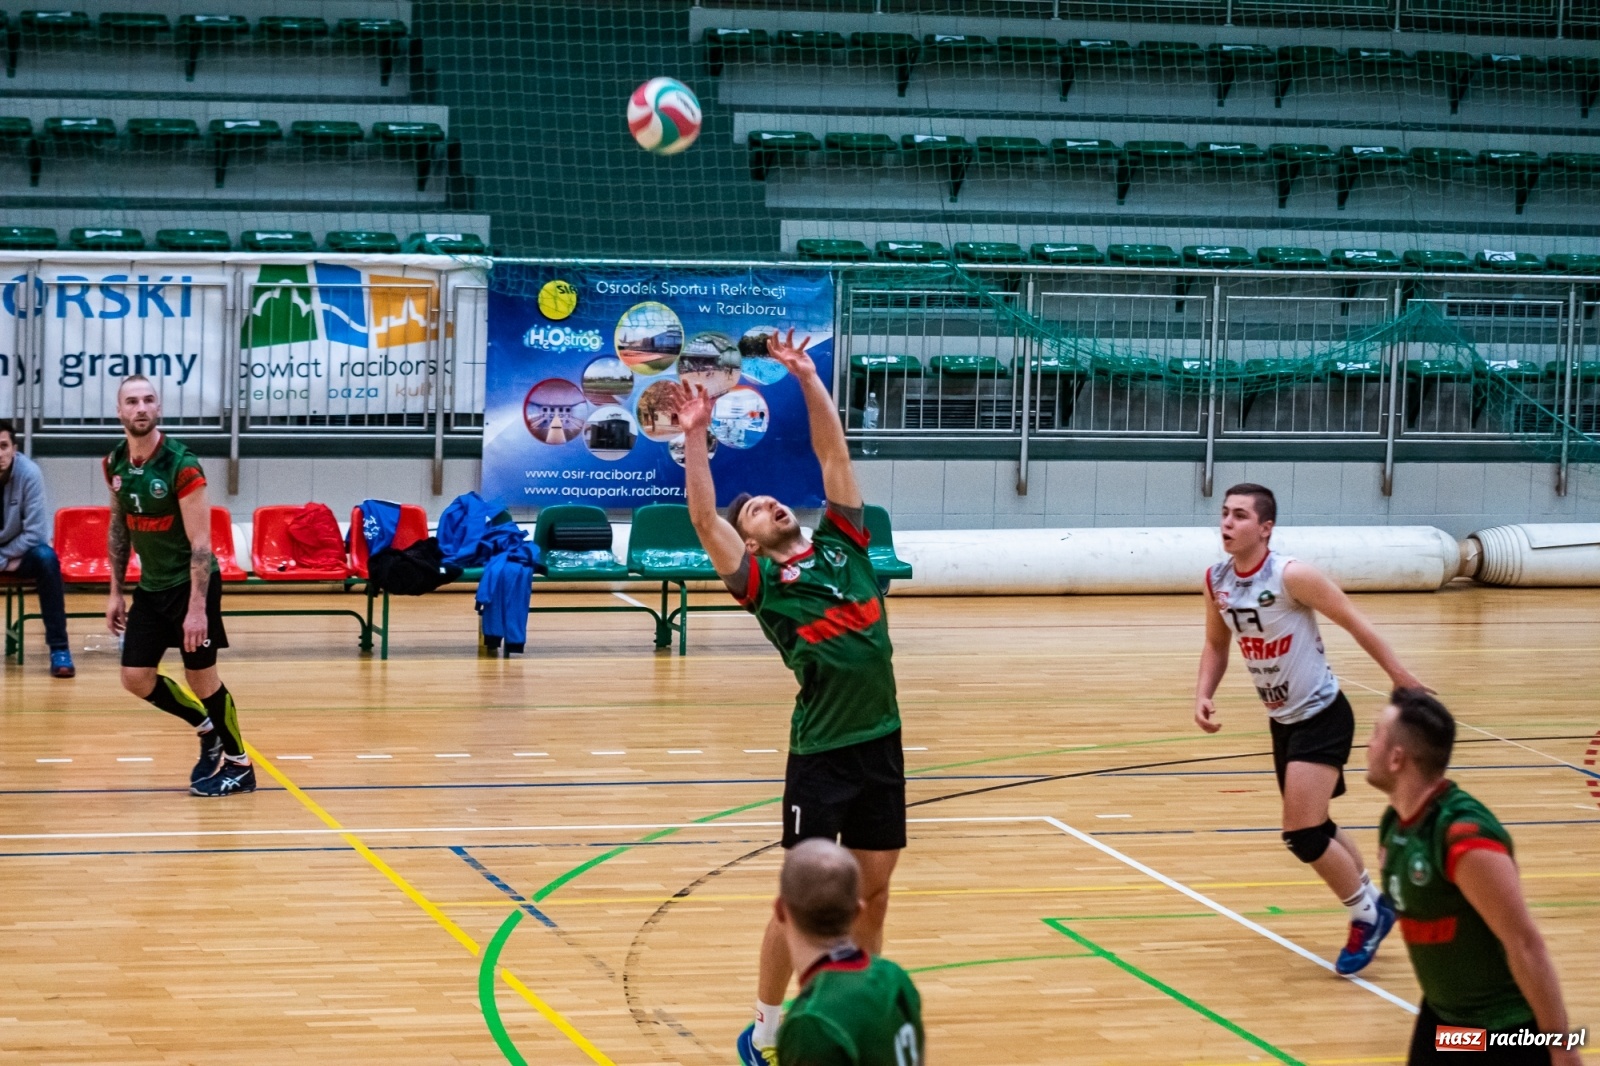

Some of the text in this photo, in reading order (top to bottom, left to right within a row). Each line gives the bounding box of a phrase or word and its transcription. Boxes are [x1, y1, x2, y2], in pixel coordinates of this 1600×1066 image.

[596, 280, 656, 294] Ośrodek
[661, 282, 707, 296] Sportu
[713, 284, 716, 294] i
[698, 302, 786, 316] w Raciborzu
[58, 351, 197, 388] gramy
[525, 469, 656, 481] www.osir-raciborz.pl
[791, 805, 801, 835] 7
